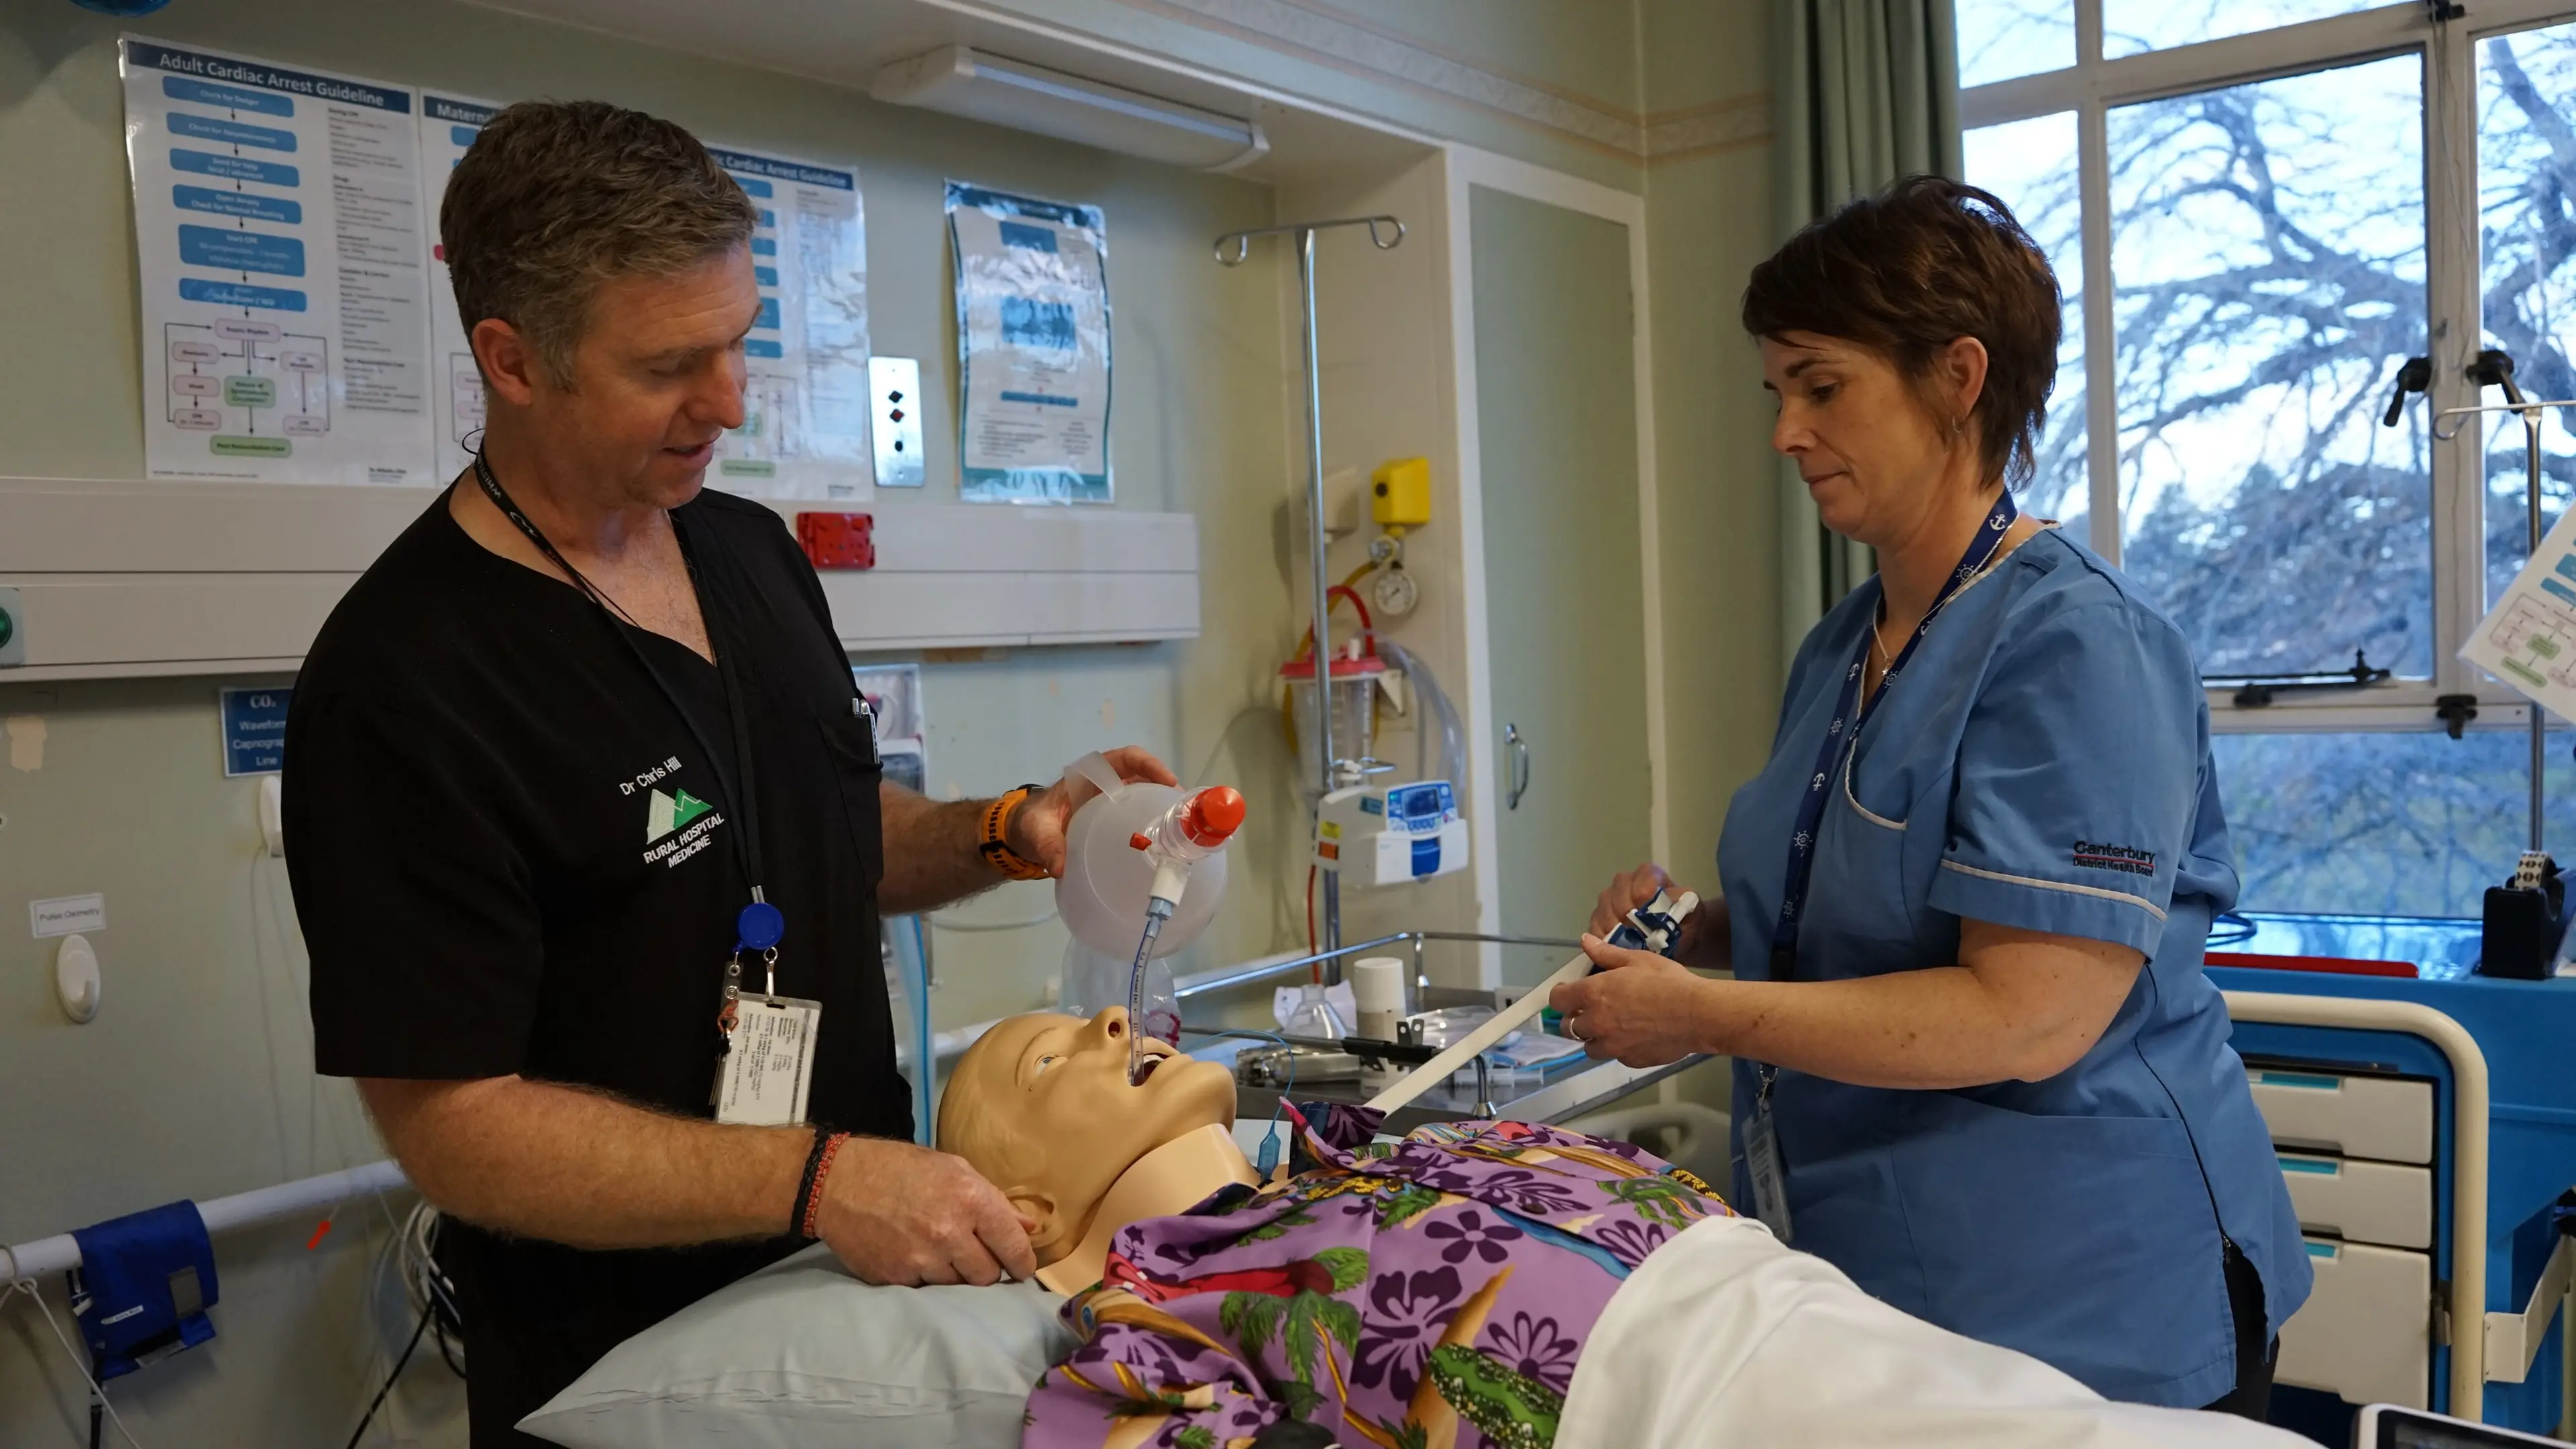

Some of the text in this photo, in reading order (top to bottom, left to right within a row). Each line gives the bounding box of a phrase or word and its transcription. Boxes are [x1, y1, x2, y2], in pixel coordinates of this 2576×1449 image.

[160, 54, 384, 106] Adult Cardiac Arrest Guideline
[726, 156, 765, 173] Cardiac
[766, 164, 798, 180] Arrest
[798, 169, 847, 188] Guideline
[256, 756, 278, 766] Line
[619, 755, 682, 796] Dr Chris Hill
[643, 812, 724, 864] RURAL HOSPITAL
[667, 834, 712, 869] MEDICINE
[2074, 841, 2156, 864] Canterbury
[2073, 857, 2107, 870] District
[2108, 862, 2135, 873] Health
